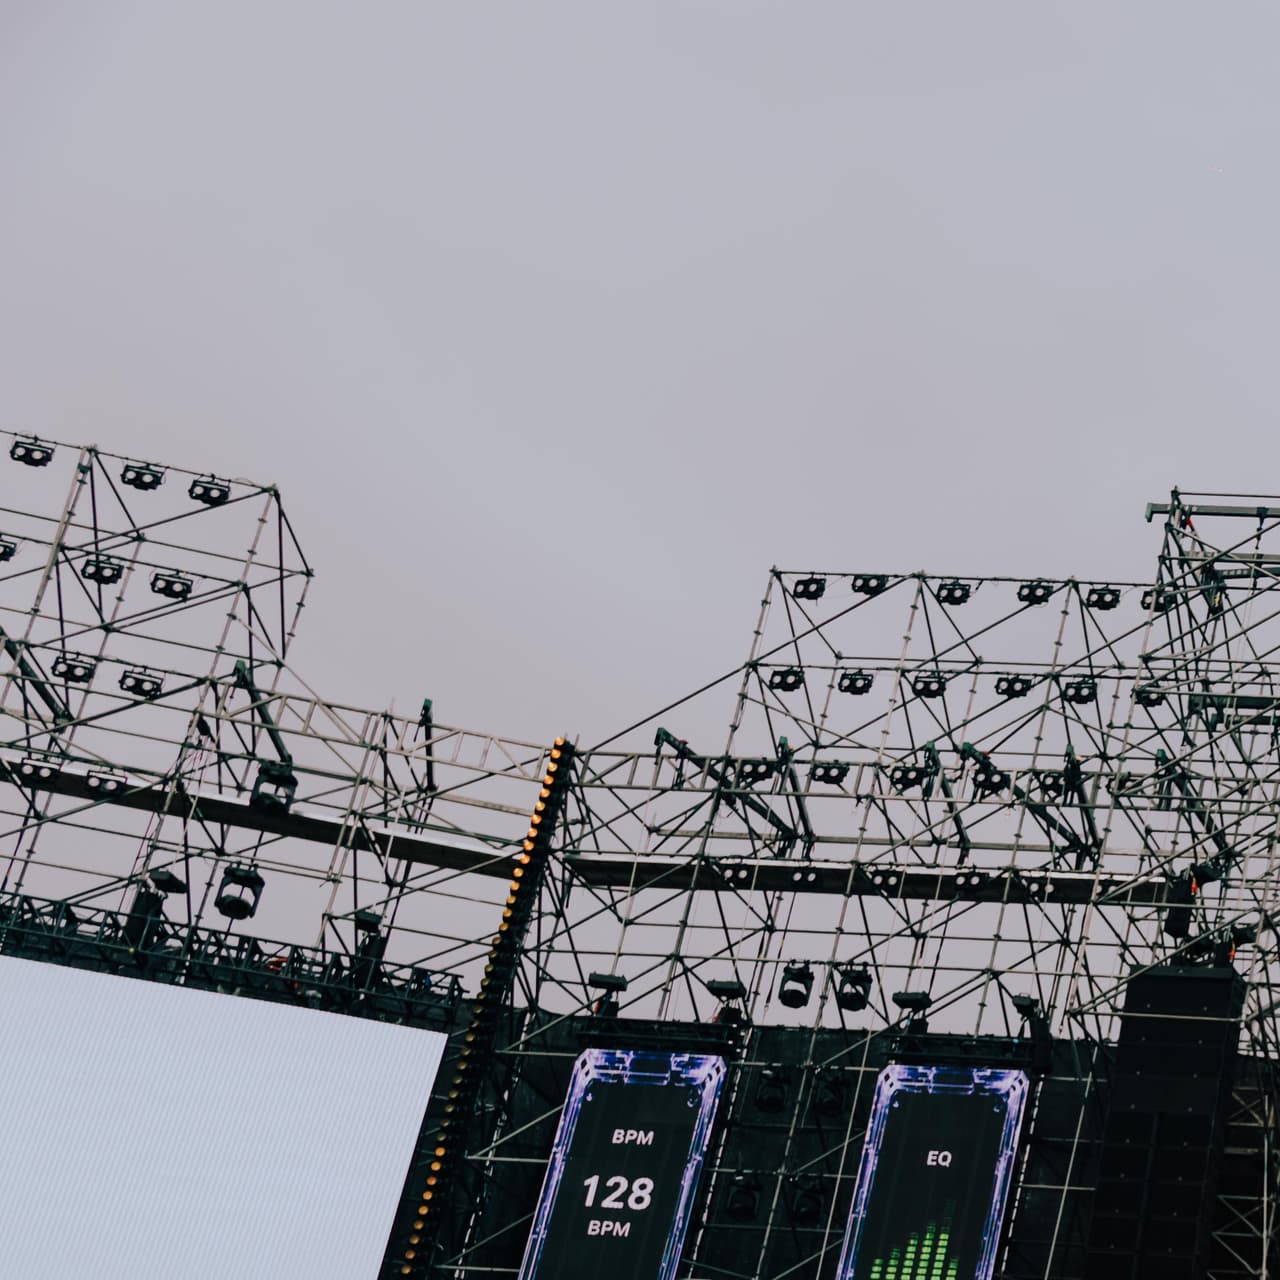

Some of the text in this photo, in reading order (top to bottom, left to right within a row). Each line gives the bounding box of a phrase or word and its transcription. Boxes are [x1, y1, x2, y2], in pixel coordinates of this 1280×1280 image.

[611, 1128, 655, 1147] BPM
[926, 1149, 953, 1168] EQ
[582, 1174, 655, 1211] 128
[586, 1219, 631, 1239] BPM
